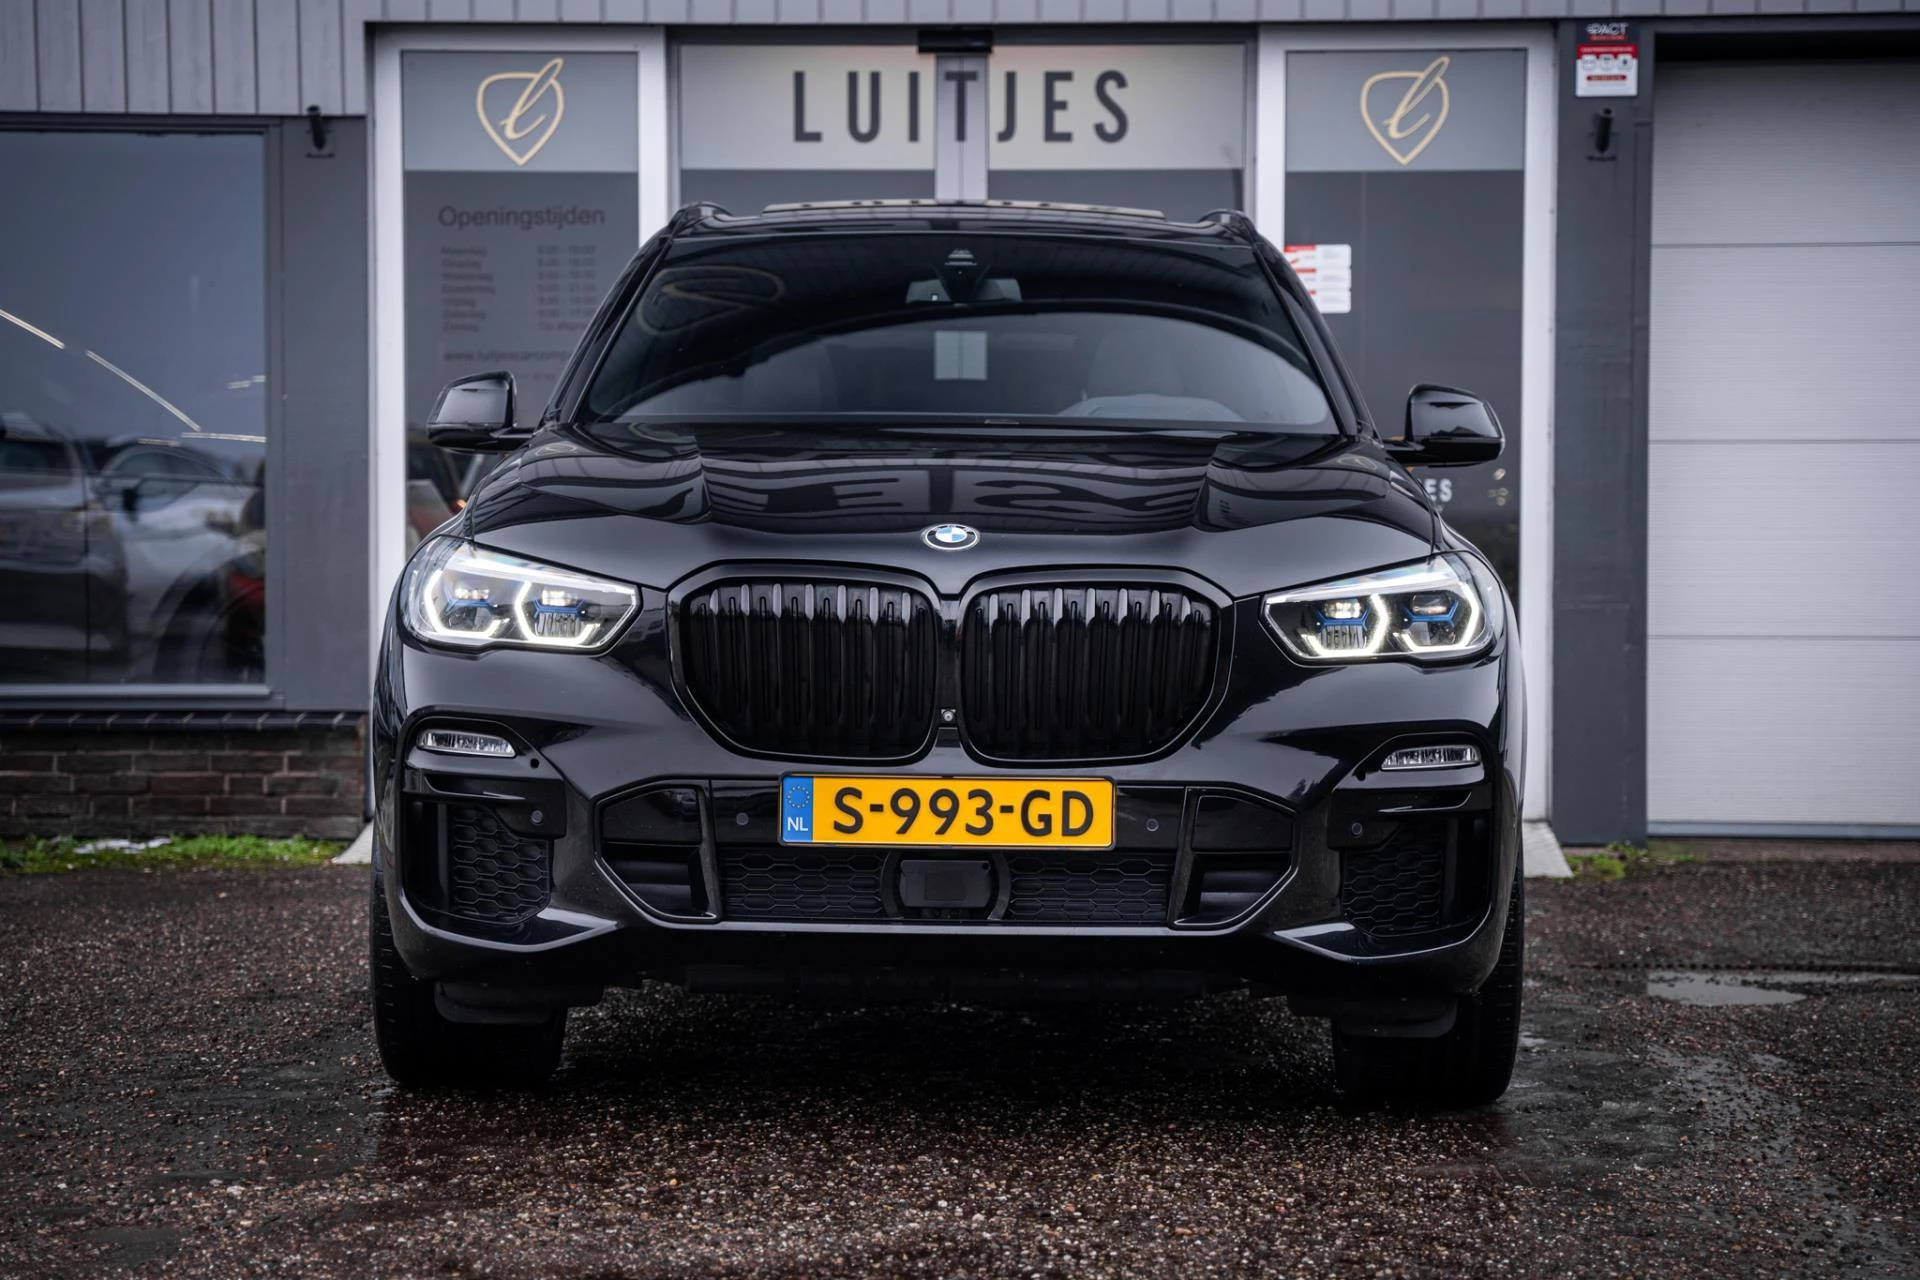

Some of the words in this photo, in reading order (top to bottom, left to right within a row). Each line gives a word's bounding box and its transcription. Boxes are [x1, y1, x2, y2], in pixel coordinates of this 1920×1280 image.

[793, 69, 1128, 143] LUITJES
[438, 206, 606, 230] Openingstijden
[787, 817, 808, 831] NL
[833, 787, 1094, 837] S-993-GD
